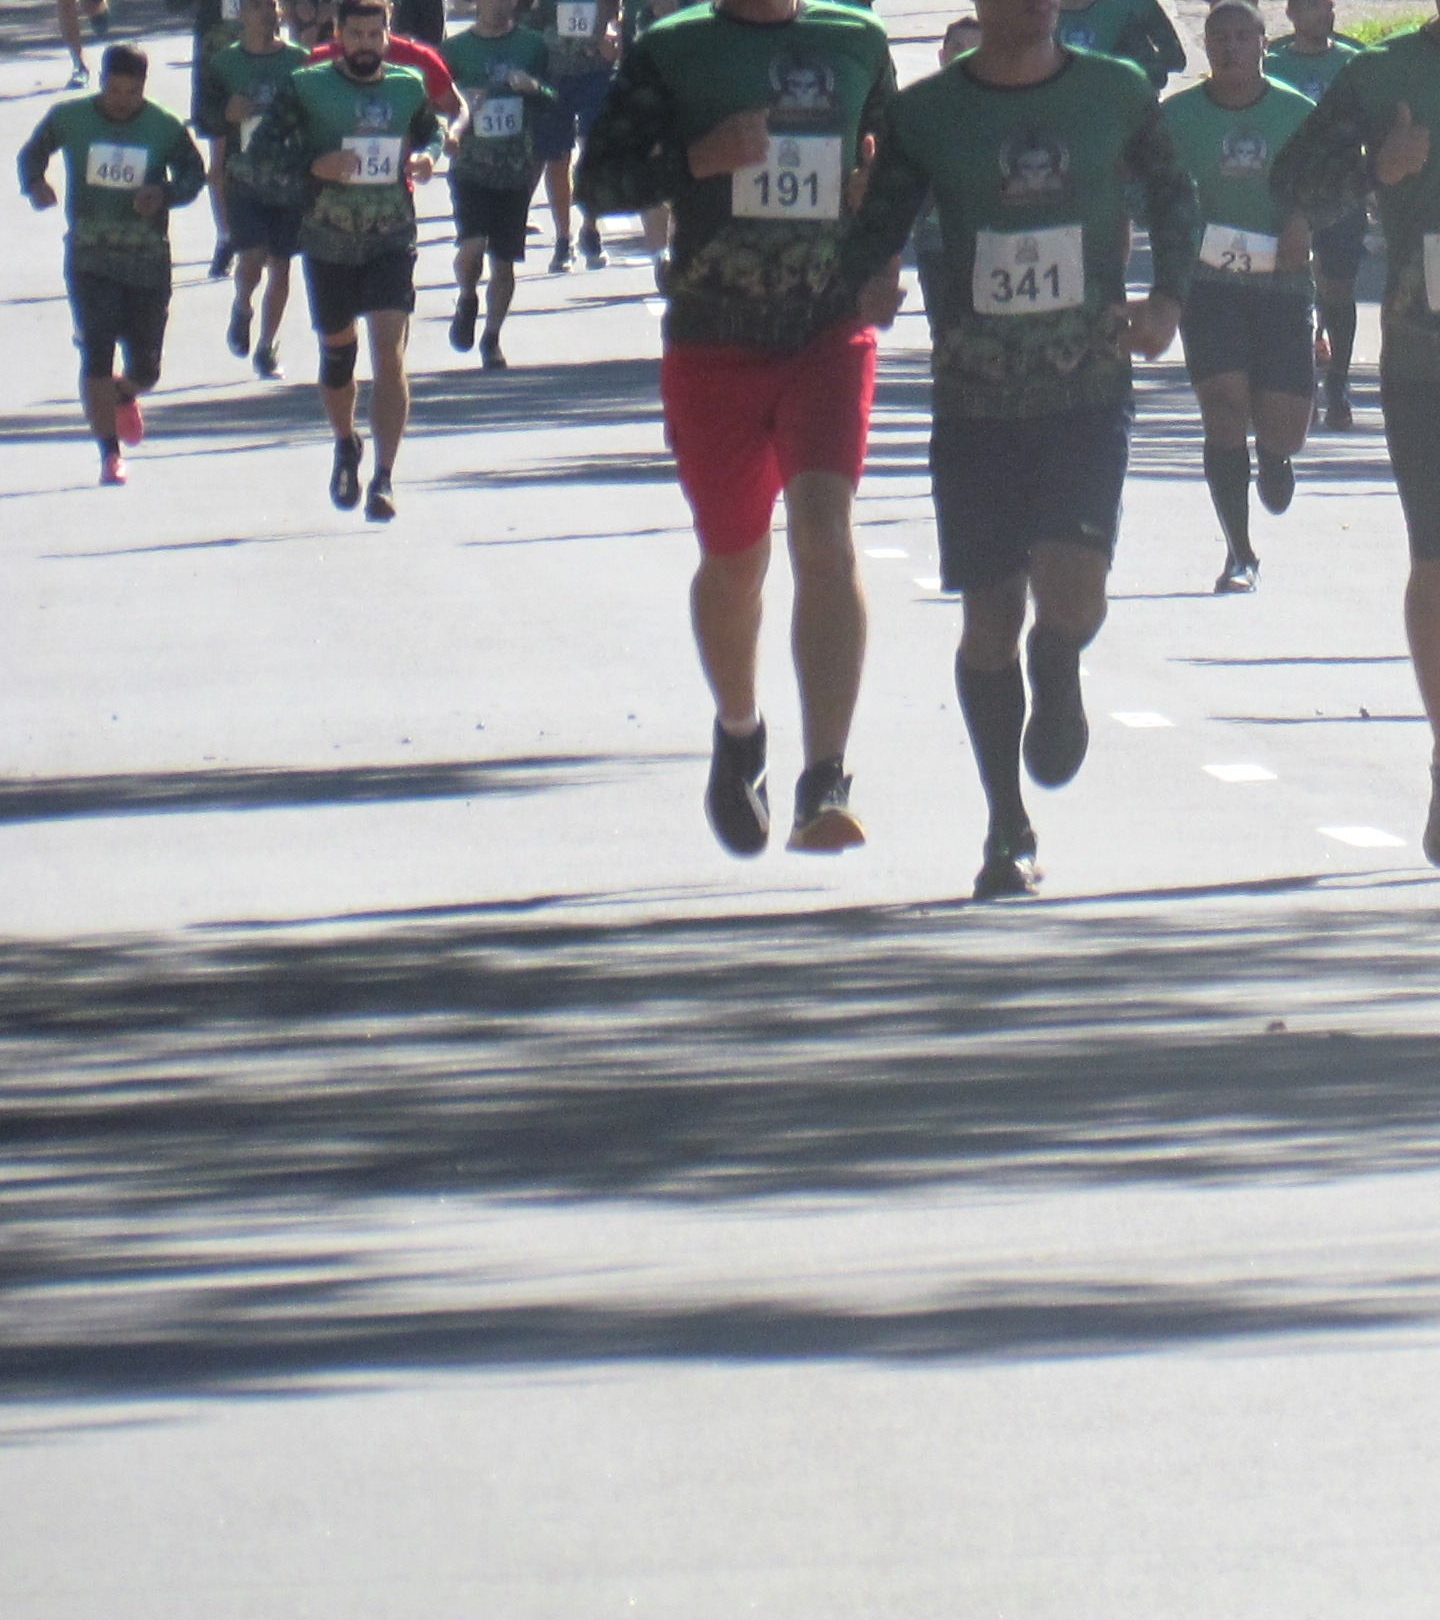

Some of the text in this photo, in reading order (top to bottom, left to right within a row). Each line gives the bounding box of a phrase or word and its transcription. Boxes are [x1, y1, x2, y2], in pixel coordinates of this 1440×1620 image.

[568, 16, 588, 32] 36
[482, 113, 516, 132] 316
[96, 162, 135, 183] 466
[355, 156, 391, 176] 154
[752, 170, 821, 206] 191
[1219, 252, 1253, 272] 23
[990, 266, 1062, 304] 341
